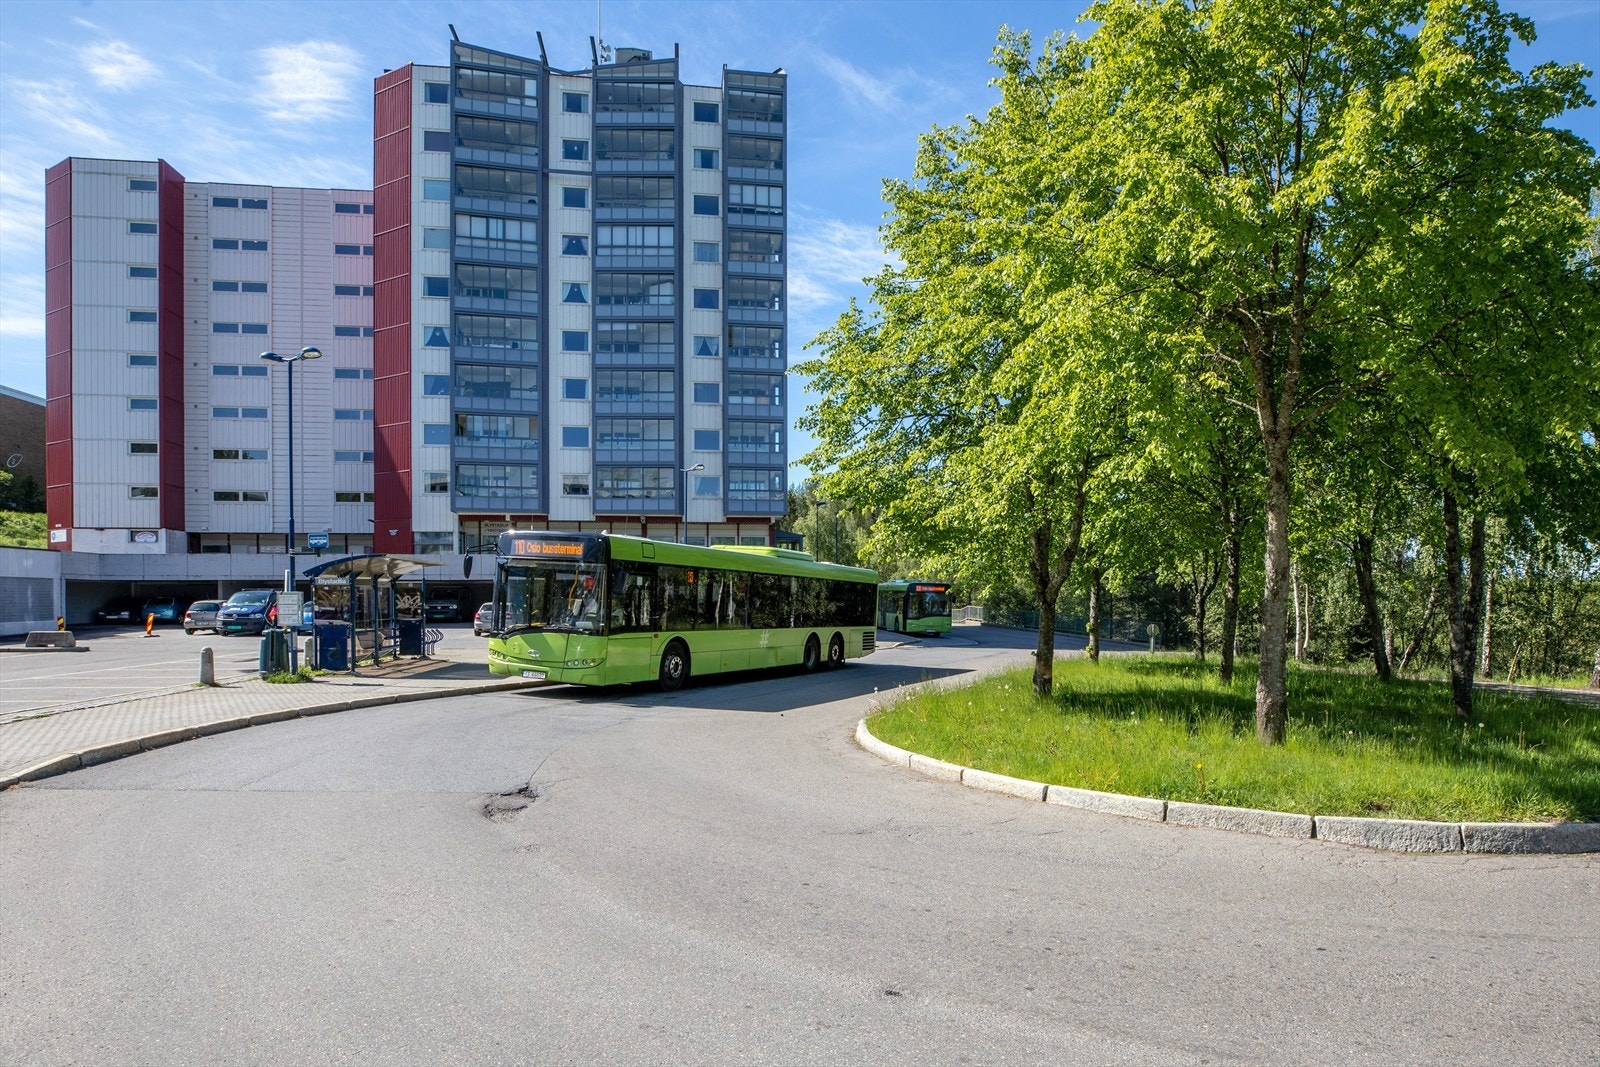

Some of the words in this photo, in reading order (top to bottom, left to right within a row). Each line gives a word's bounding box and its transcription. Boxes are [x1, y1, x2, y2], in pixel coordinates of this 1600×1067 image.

[515, 540, 525, 554] 110
[527, 542, 541, 553] Oslo
[542, 542, 583, 555] bussterminal
